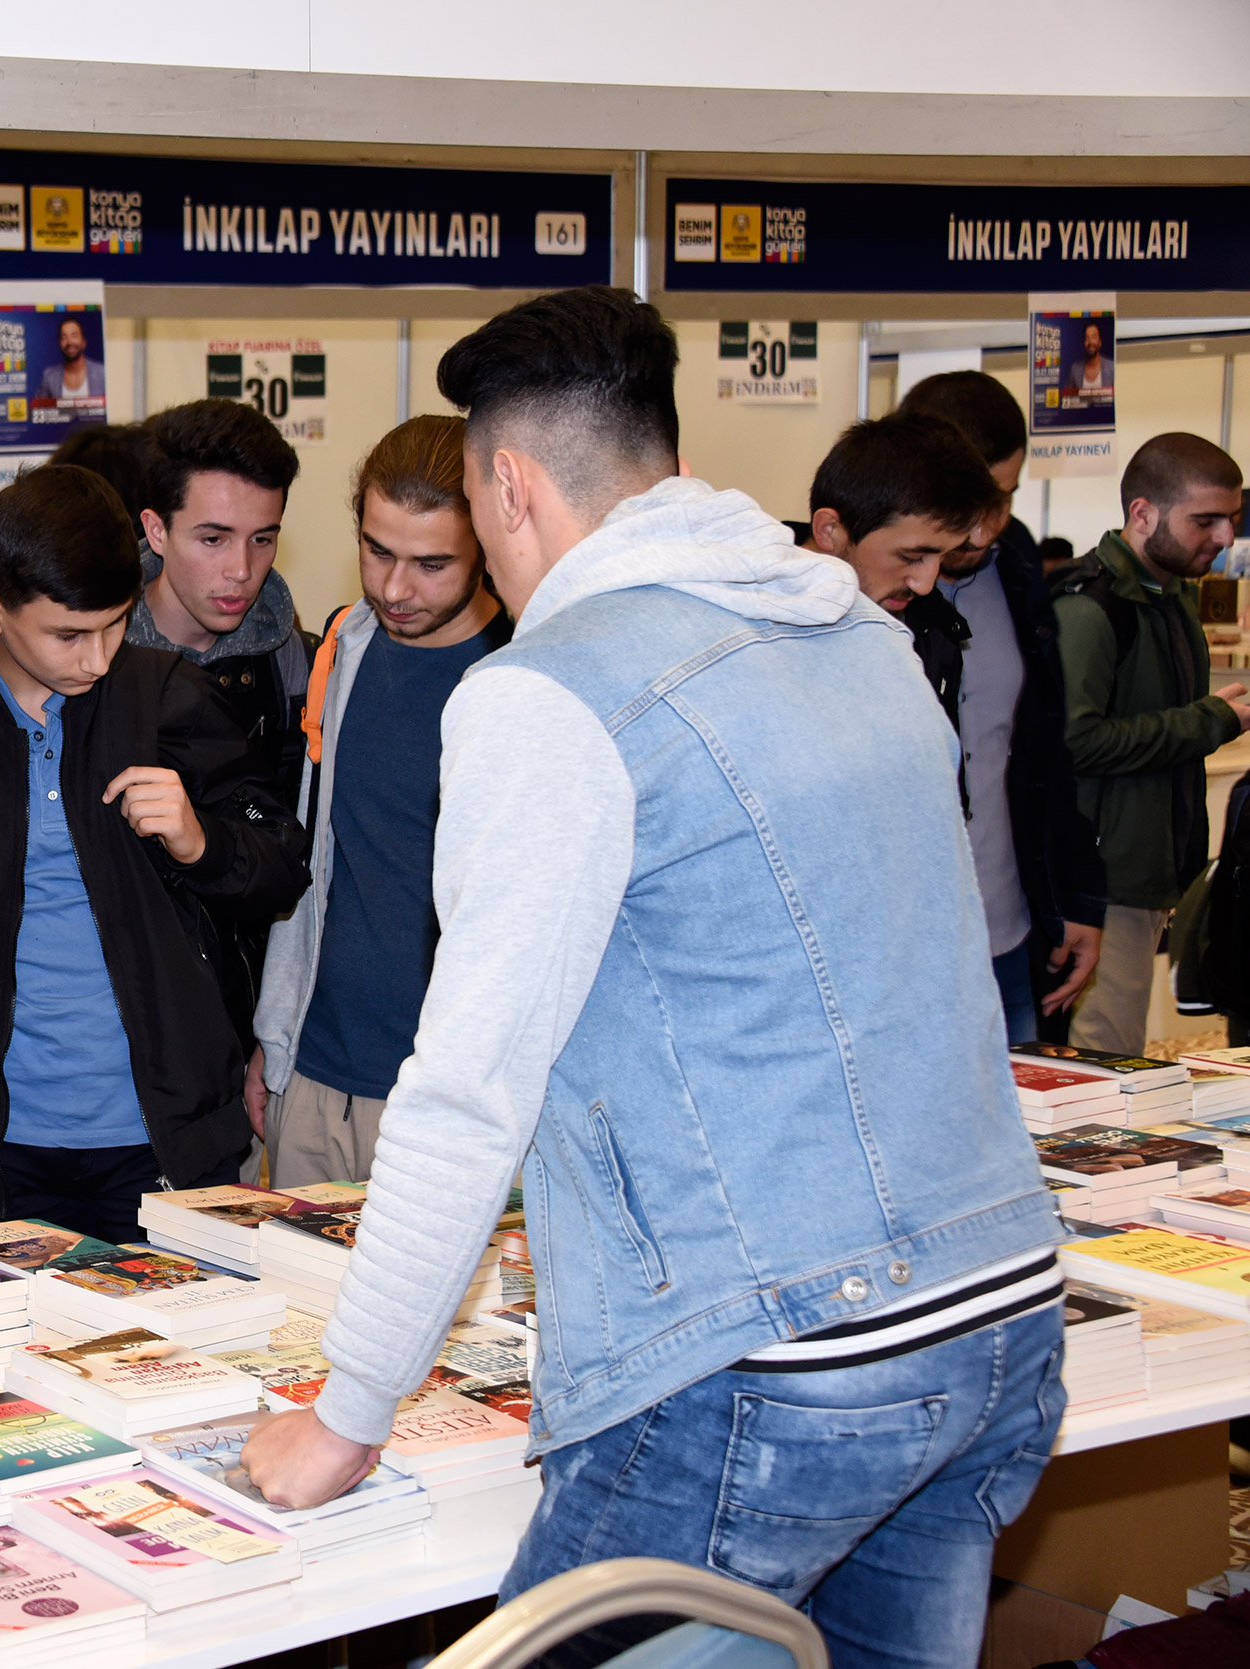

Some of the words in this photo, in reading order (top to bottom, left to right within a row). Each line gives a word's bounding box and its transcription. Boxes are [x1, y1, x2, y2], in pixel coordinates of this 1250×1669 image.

[90, 206, 142, 228] kitap
[183, 196, 320, 254] İNKILAP
[328, 208, 500, 259] YAYINLARI
[545, 221, 579, 247] 161
[948, 212, 1051, 261] İNKILAP
[1058, 219, 1188, 260] YAYINLARI
[751, 341, 786, 378] 30
[45, 1441, 96, 1459] KALP
[15, 1570, 78, 1591] Annem
[18, 1582, 62, 1598] Beni
